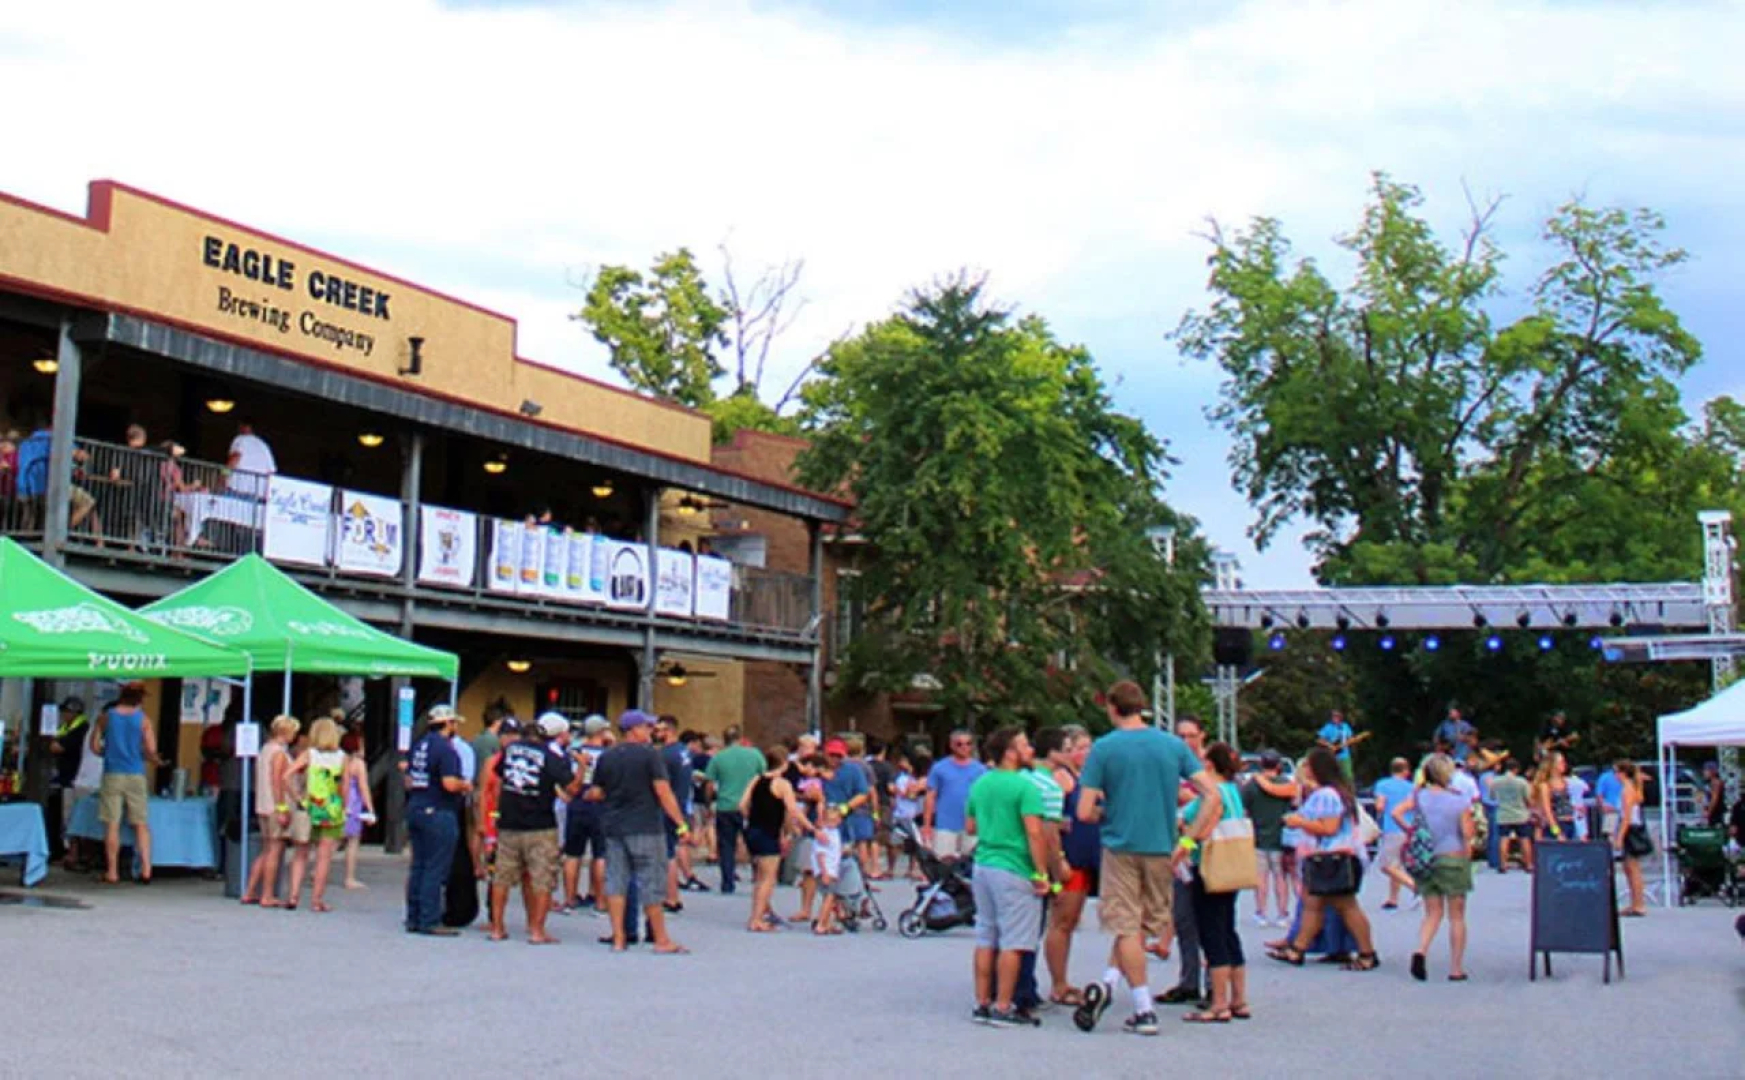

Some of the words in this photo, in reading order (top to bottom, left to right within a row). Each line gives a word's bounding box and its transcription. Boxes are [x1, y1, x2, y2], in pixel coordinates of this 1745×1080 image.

[203, 235, 294, 290] EAGLE
[308, 270, 391, 320] CREEK
[217, 286, 291, 333] Brewing
[300, 311, 375, 356] Company
